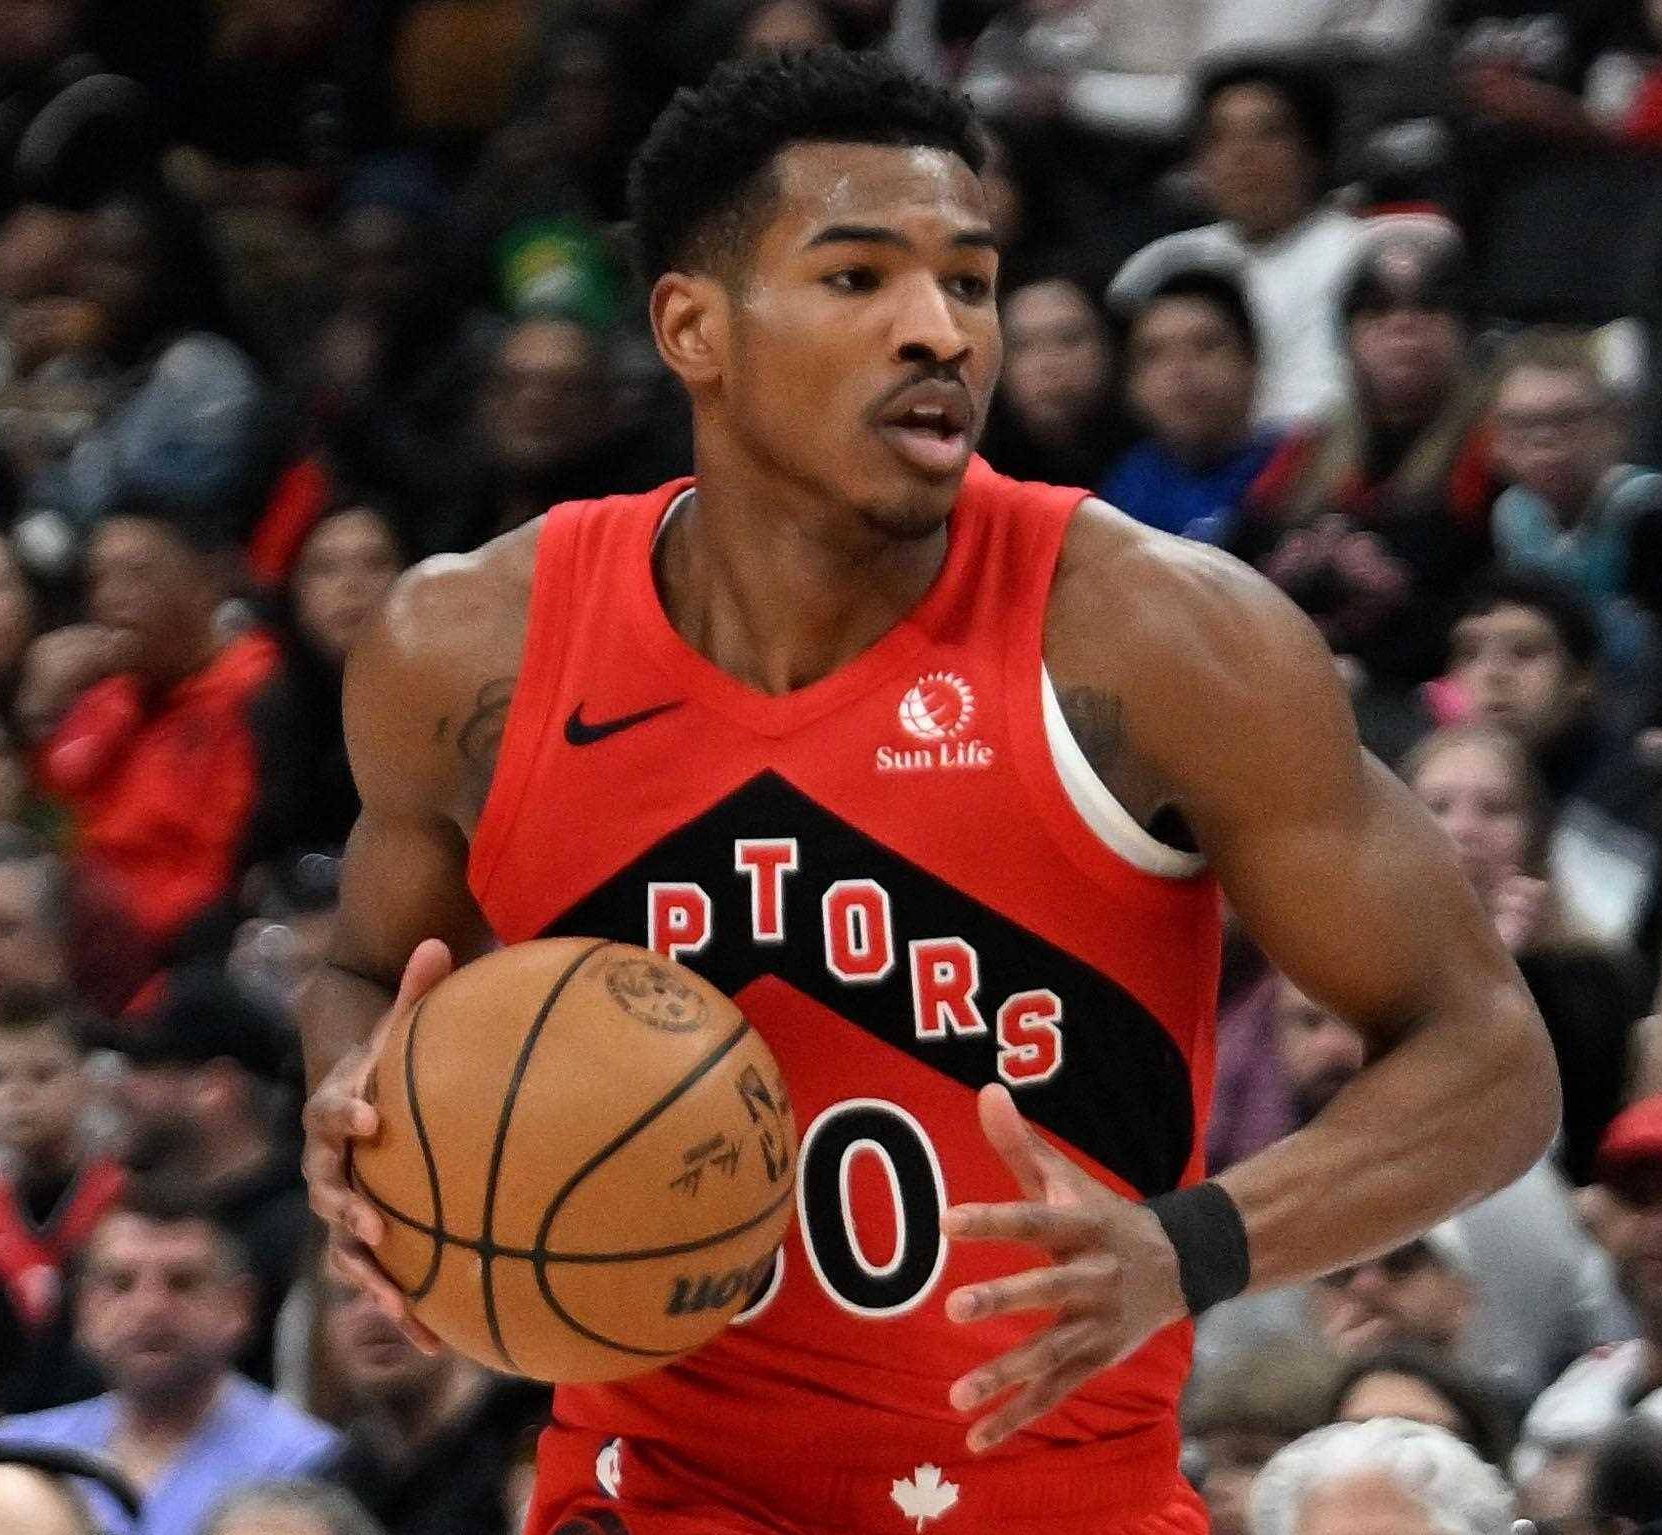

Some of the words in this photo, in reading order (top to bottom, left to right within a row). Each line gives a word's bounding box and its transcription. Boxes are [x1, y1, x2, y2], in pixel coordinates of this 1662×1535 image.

[876, 746, 933, 770] Sun
[940, 740, 995, 767] Life
[647, 837, 1064, 1086] PTORS
[729, 1097, 949, 1326] 0
